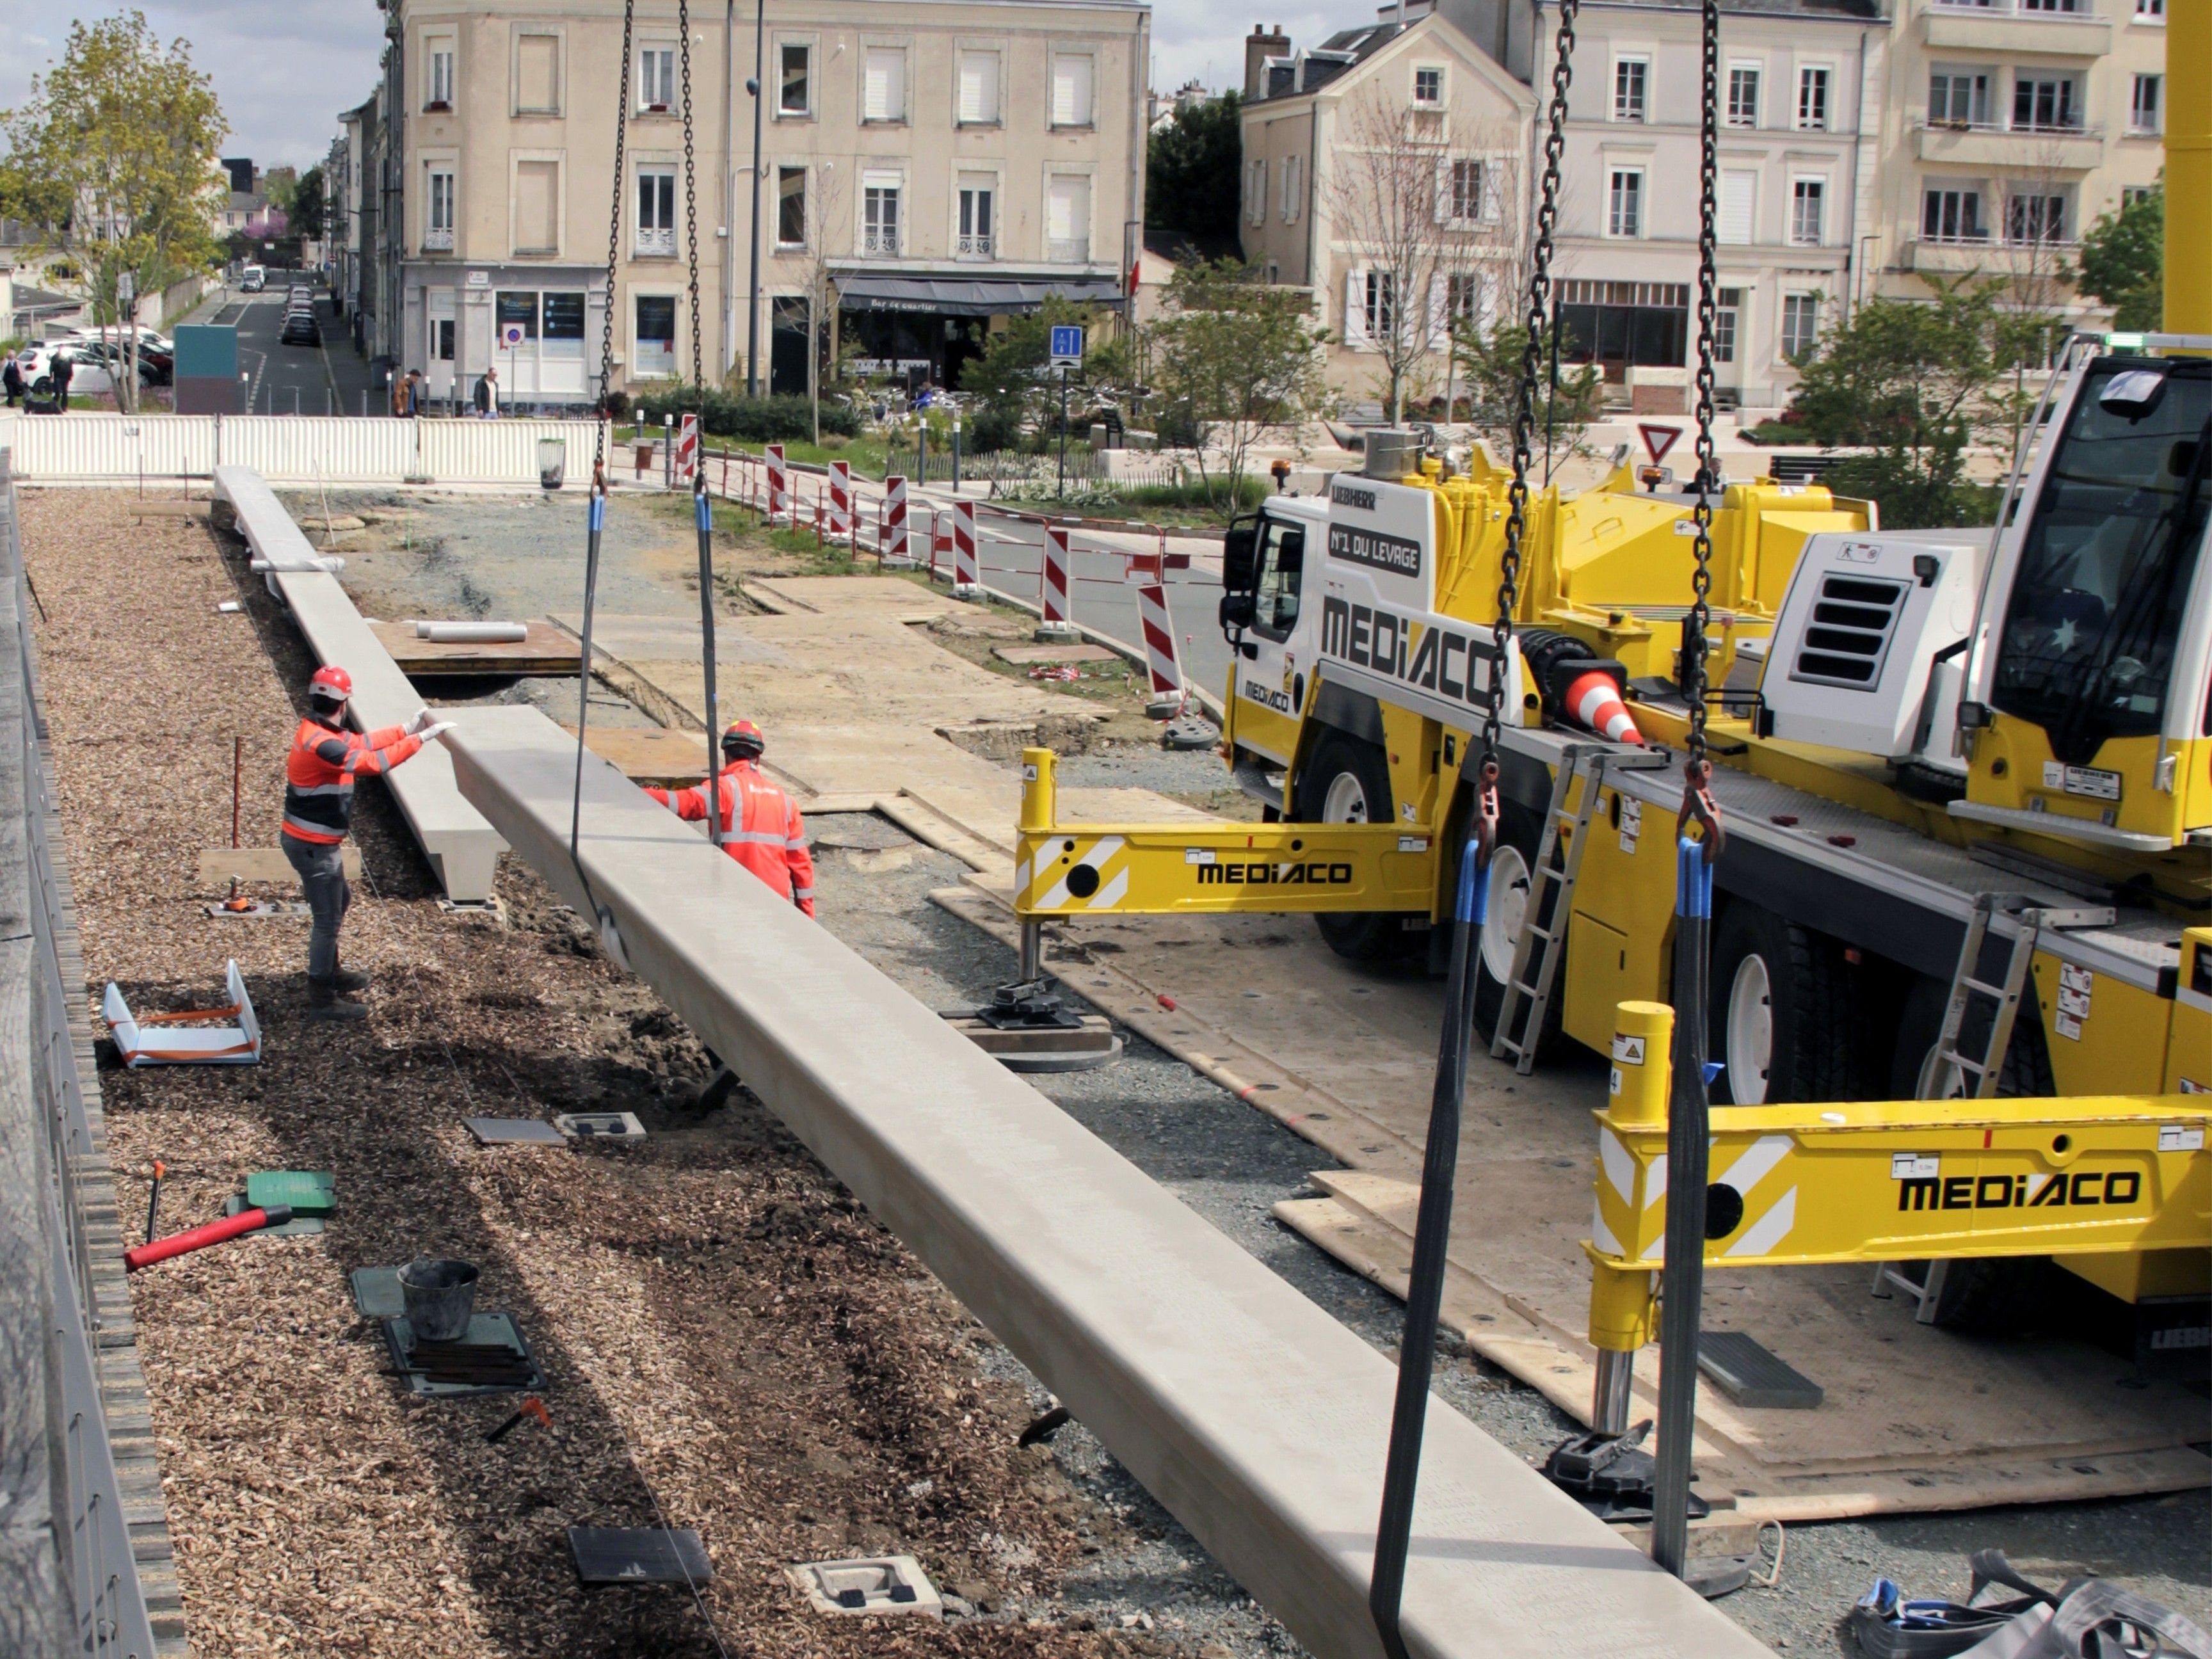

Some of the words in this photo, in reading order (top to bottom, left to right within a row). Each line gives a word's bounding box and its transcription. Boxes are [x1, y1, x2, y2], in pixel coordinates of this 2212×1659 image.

[1331, 485, 1375, 511] LIEBHERR
[1353, 535, 1369, 557] DU
[1372, 540, 1418, 570] LEVAGE
